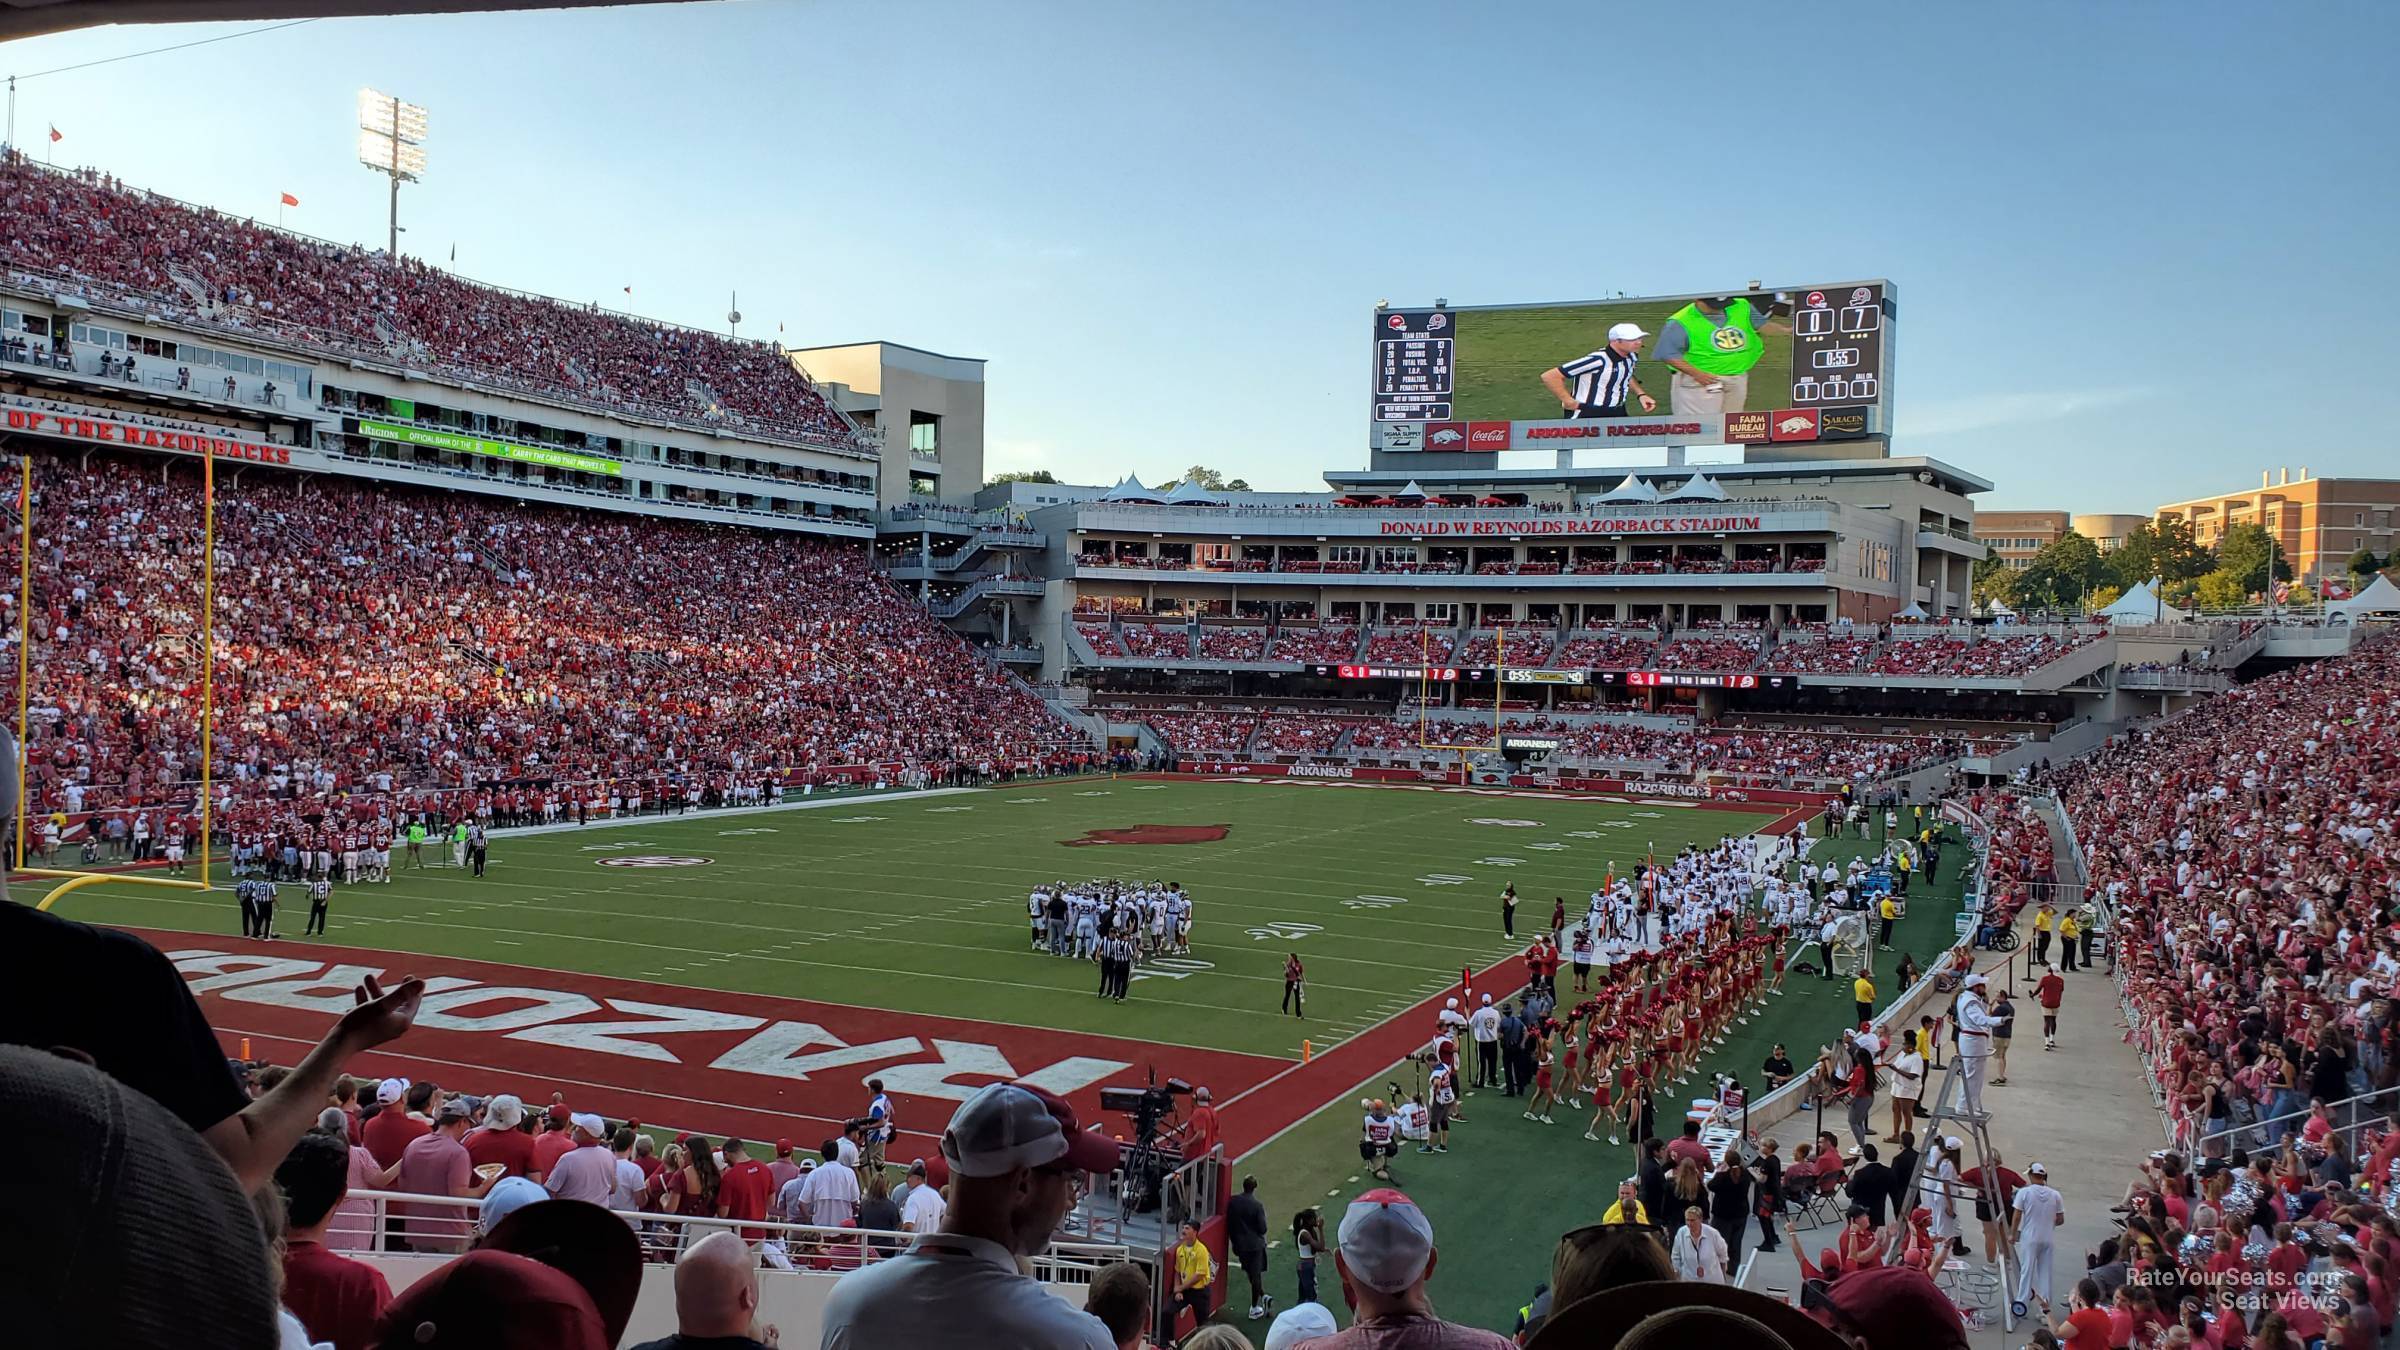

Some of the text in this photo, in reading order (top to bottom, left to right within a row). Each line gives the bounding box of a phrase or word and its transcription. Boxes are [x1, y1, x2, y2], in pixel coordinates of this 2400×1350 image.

[1810, 312, 1819, 332] 0
[1855, 309, 1864, 329] 7
[1826, 351, 1848, 366] 0:55
[1804, 385, 1808, 399] 1
[1835, 383, 1839, 397] 1
[1863, 382, 1867, 396] 1
[1740, 415, 1765, 423] FARM
[1527, 423, 1702, 439] ARKANSAS RAZORBACKS
[1729, 423, 1765, 432] BUREAU
[9, 410, 290, 463] OF THE RAZORBACKS
[1381, 517, 1760, 535] DONALD W REYNOLDS RAZORBACK STADIUM
[1433, 669, 1439, 679] 7
[1508, 670, 1532, 681] 0:55
[1568, 672, 1582, 682] 40
[1729, 676, 1735, 687] 7
[1506, 739, 1558, 748] ARKANSAS
[1287, 765, 1353, 778] ARKANSAS
[346, 841, 356, 849] 51
[1081, 905, 1090, 914] 23
[1160, 907, 1164, 917] 0
[1444, 1093, 1450, 1101] 5
